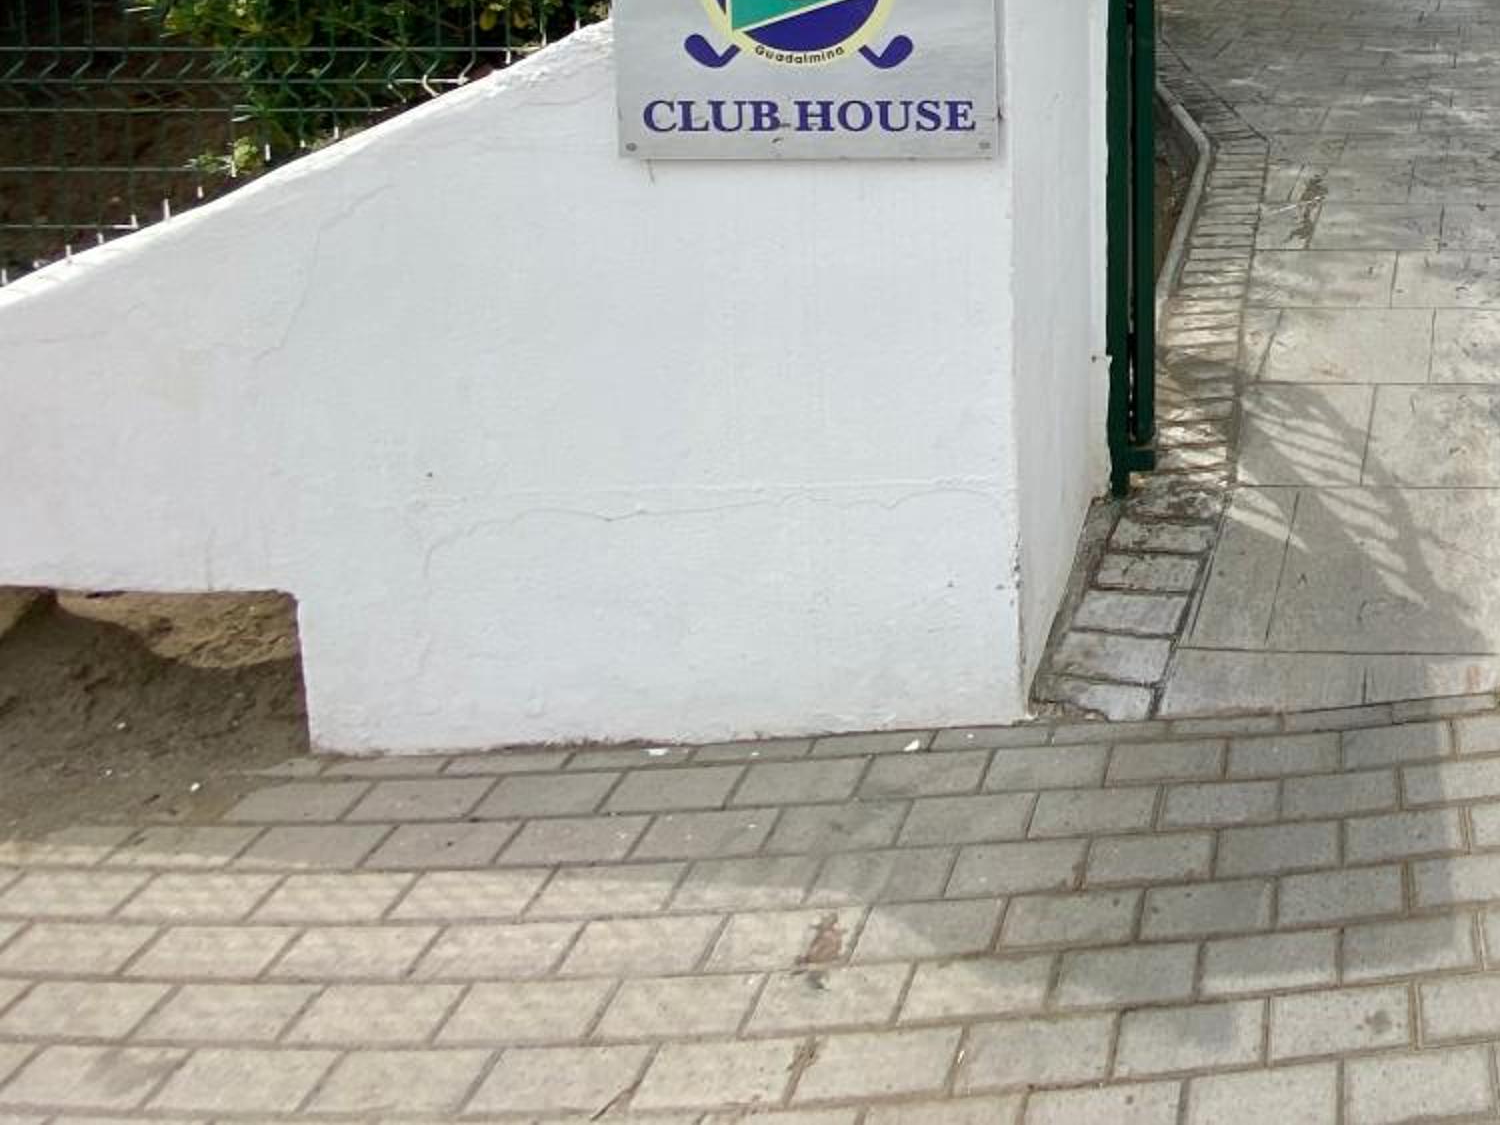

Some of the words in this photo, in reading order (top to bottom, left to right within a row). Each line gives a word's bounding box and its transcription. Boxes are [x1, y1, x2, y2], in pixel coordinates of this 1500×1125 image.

[754, 44, 845, 64] Guadalmina
[643, 100, 780, 132] CLUB
[799, 100, 976, 132] HOUSE
